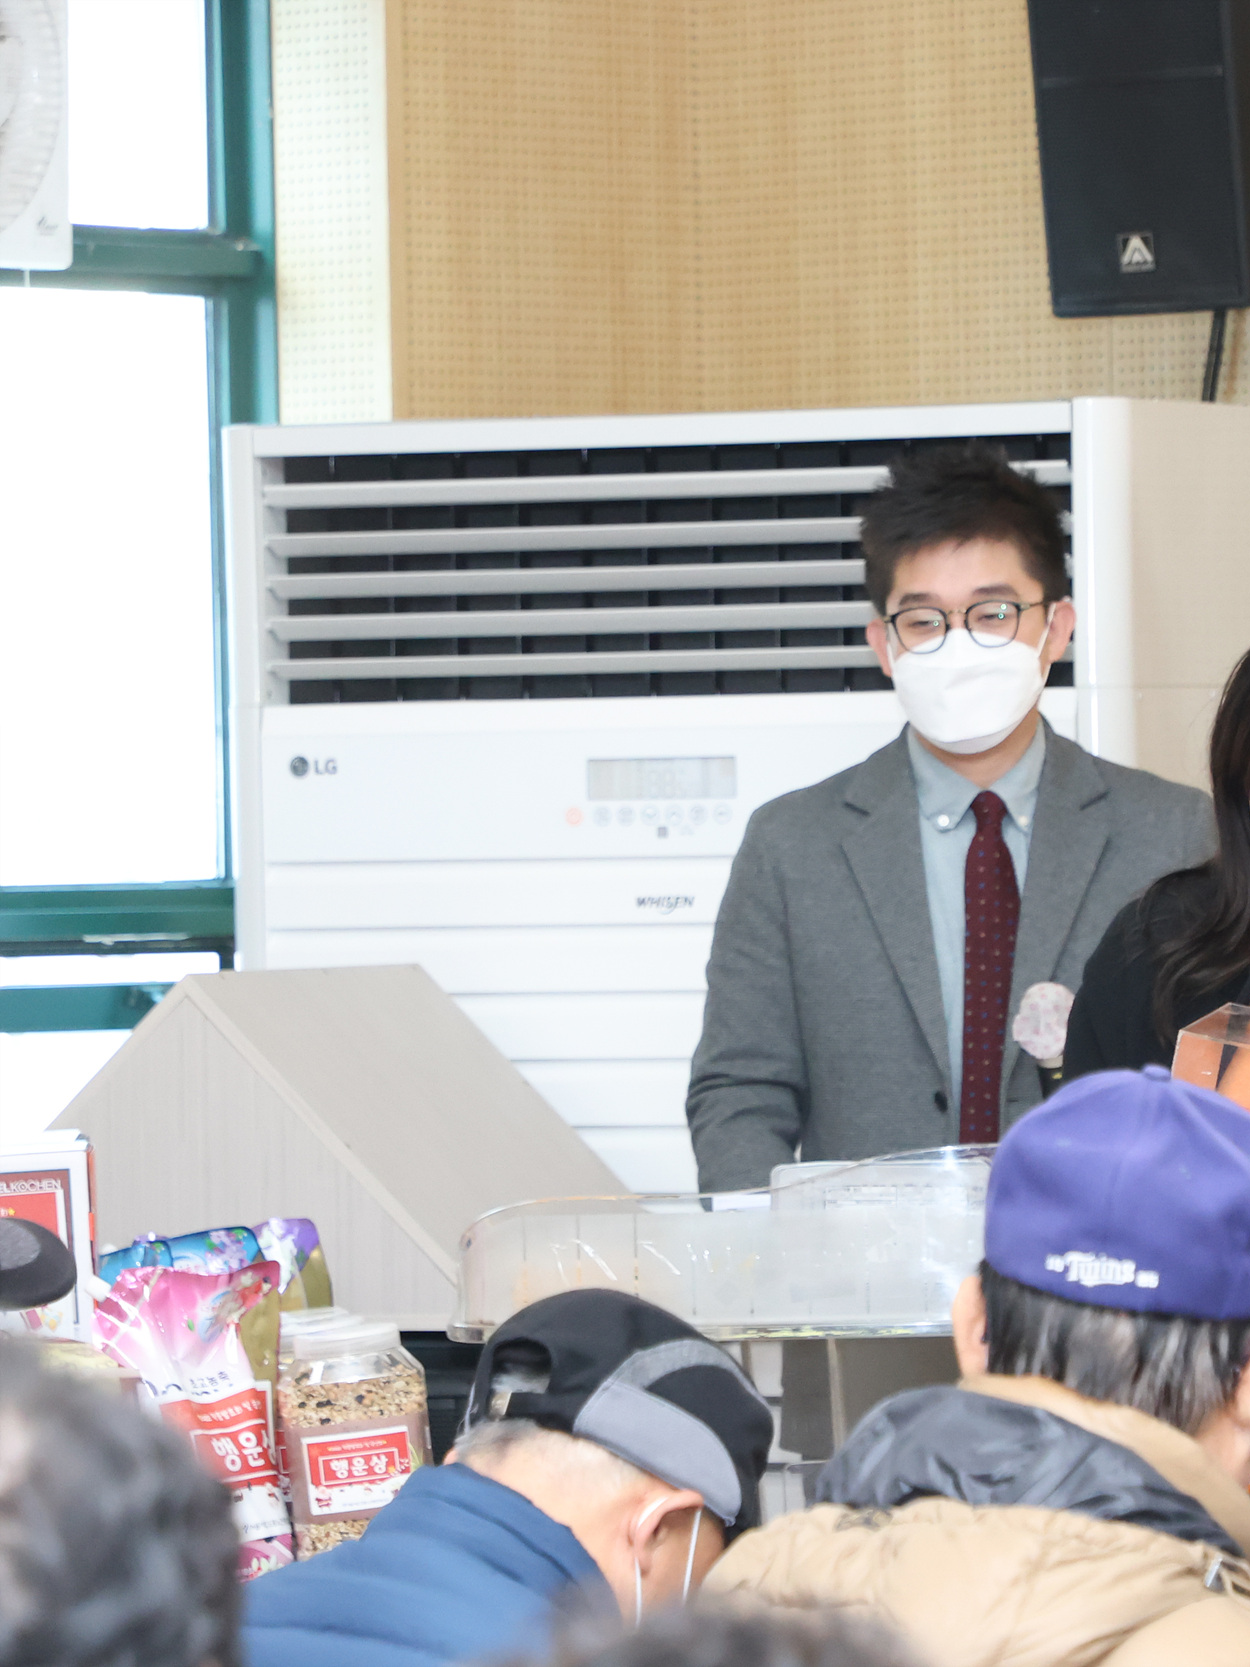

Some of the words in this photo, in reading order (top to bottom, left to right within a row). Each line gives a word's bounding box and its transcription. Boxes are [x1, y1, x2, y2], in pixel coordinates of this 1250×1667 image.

[313, 758, 338, 776] LG
[635, 895, 696, 910] WHISEN
[1063, 1251, 1136, 1287] Twins
[329, 1453, 389, 1480] 행운상
